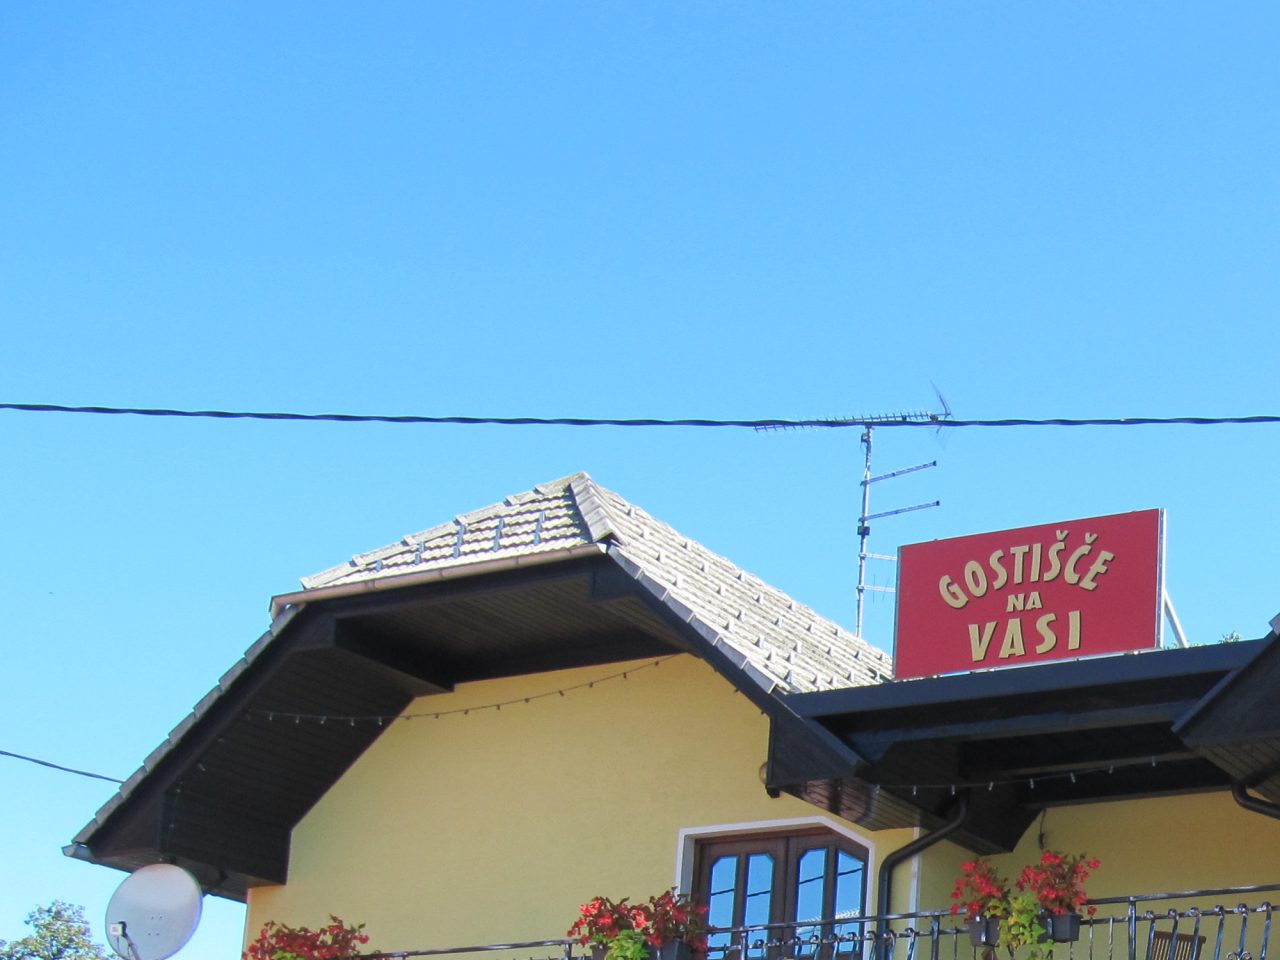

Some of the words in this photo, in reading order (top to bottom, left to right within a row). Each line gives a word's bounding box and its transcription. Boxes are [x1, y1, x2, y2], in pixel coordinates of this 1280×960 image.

[938, 529, 1115, 609] GOSTIŠČE
[1006, 591, 1043, 612] NA
[968, 610, 1081, 662] VASI
